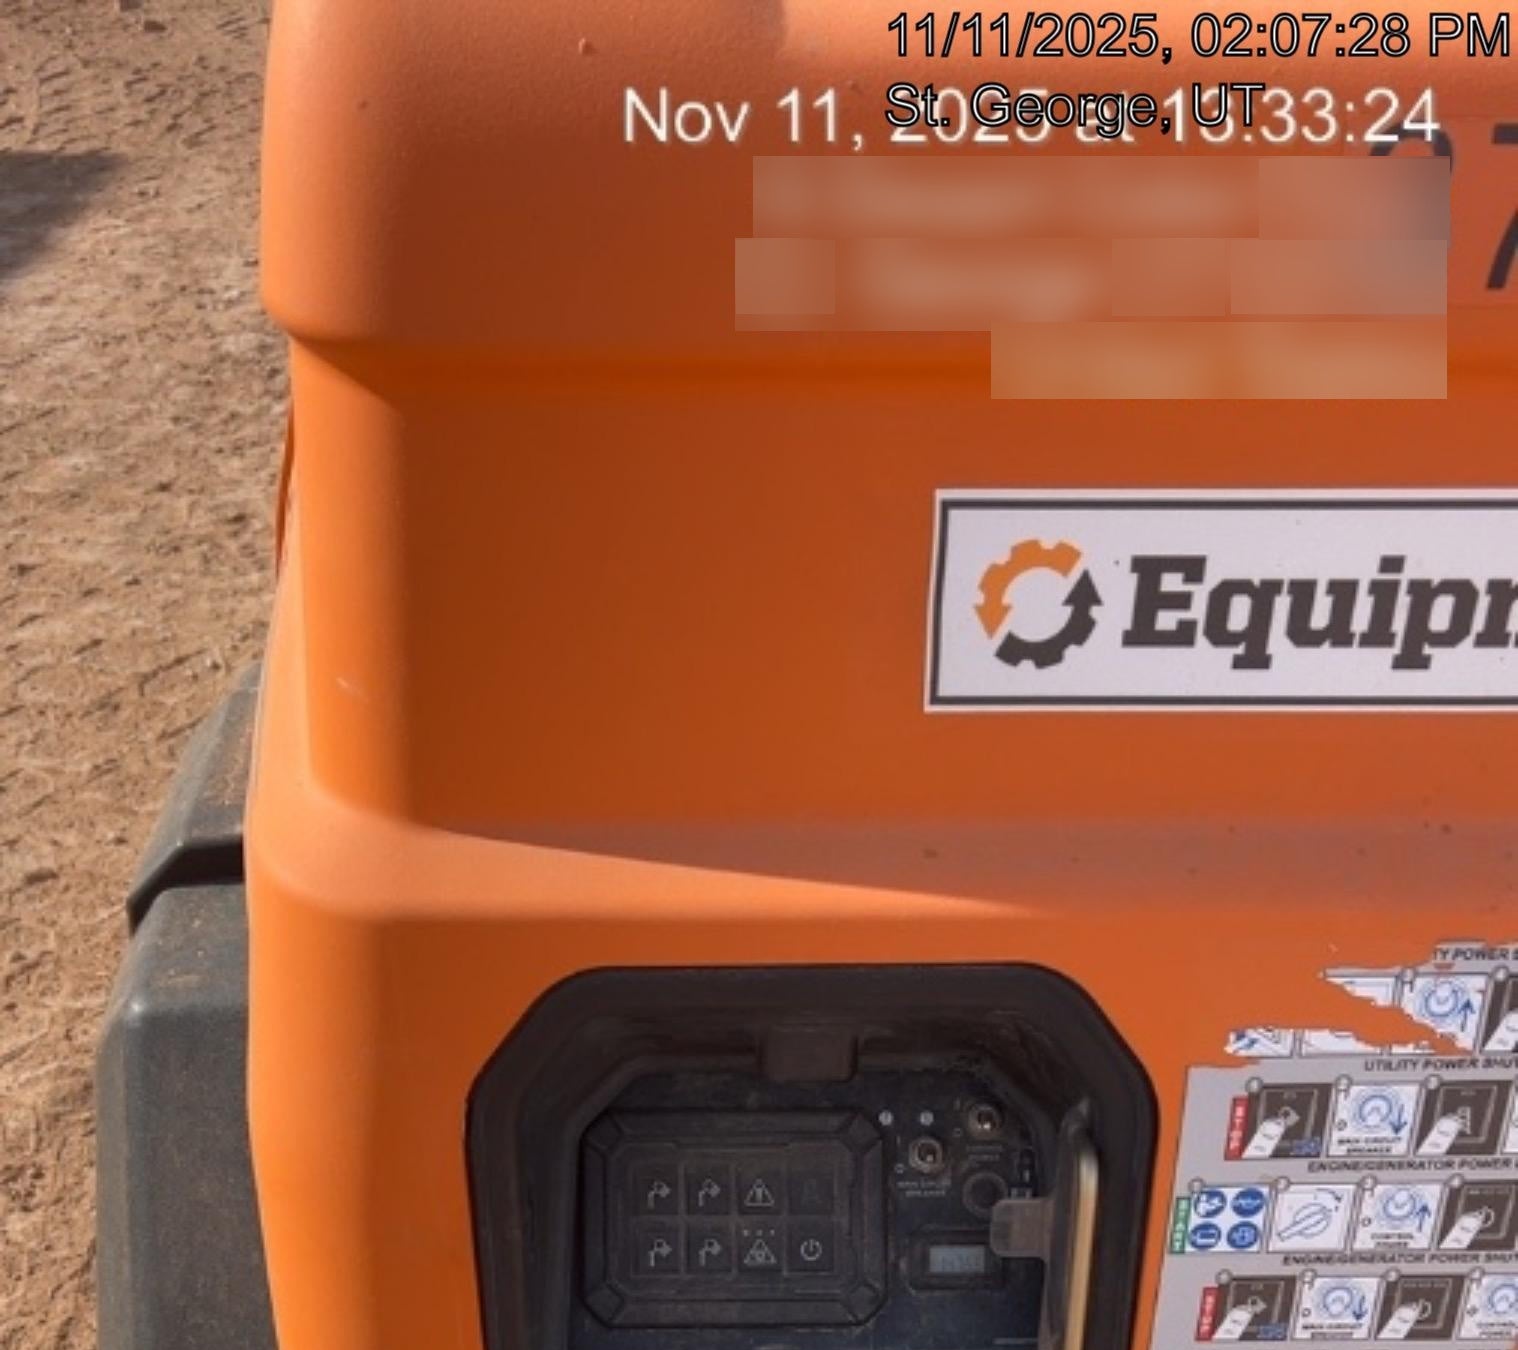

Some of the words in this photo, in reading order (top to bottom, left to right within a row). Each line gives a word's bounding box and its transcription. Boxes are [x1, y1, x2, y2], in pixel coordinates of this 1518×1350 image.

[1364, 1058, 1417, 1072] UTILITY
[1422, 1057, 1479, 1070] POWER
[1429, 1252, 1479, 1264] POWER
